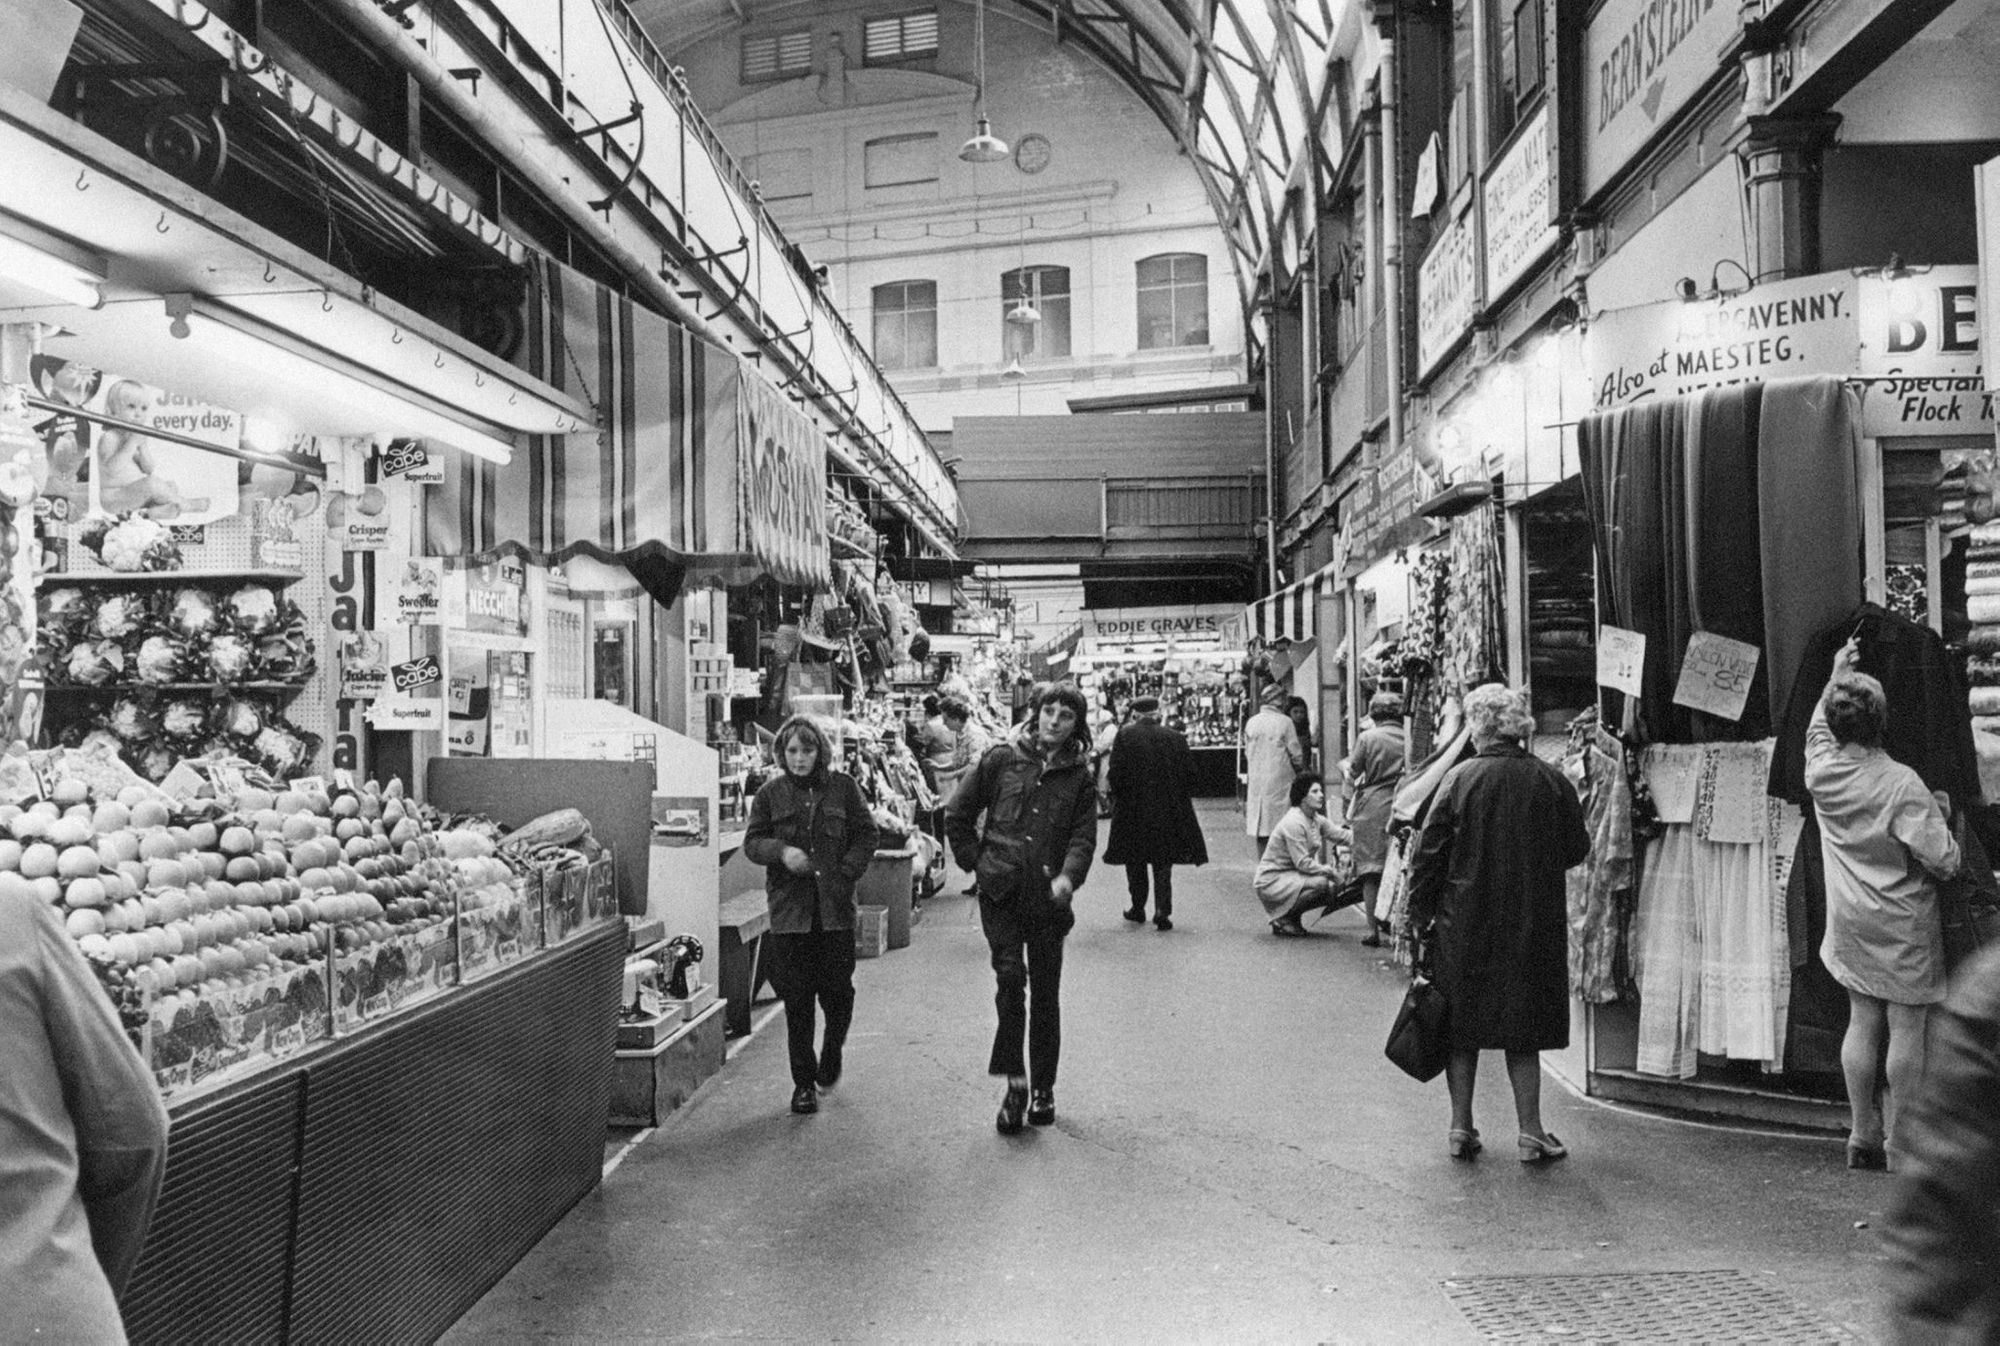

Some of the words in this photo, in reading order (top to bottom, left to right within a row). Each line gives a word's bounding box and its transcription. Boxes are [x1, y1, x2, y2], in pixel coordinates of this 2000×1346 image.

[1676, 290, 1851, 343] RGAVENNY.
[1598, 367, 1644, 406] Also
[1650, 348, 1669, 378] at
[1901, 395, 1962, 422] Flock
[153, 415, 199, 432] every
[201, 410, 233, 432] day.
[383, 450, 425, 472] cape
[404, 471, 442, 483] Superfruit
[349, 524, 388, 536] Crisper
[398, 594, 438, 608] Sweeter
[1097, 619, 1146, 634] EDDIE
[1150, 616, 1216, 633] GRAVES
[344, 669, 387, 682] Juicier
[396, 665, 439, 687] cape
[392, 707, 432, 719] Superfruit
